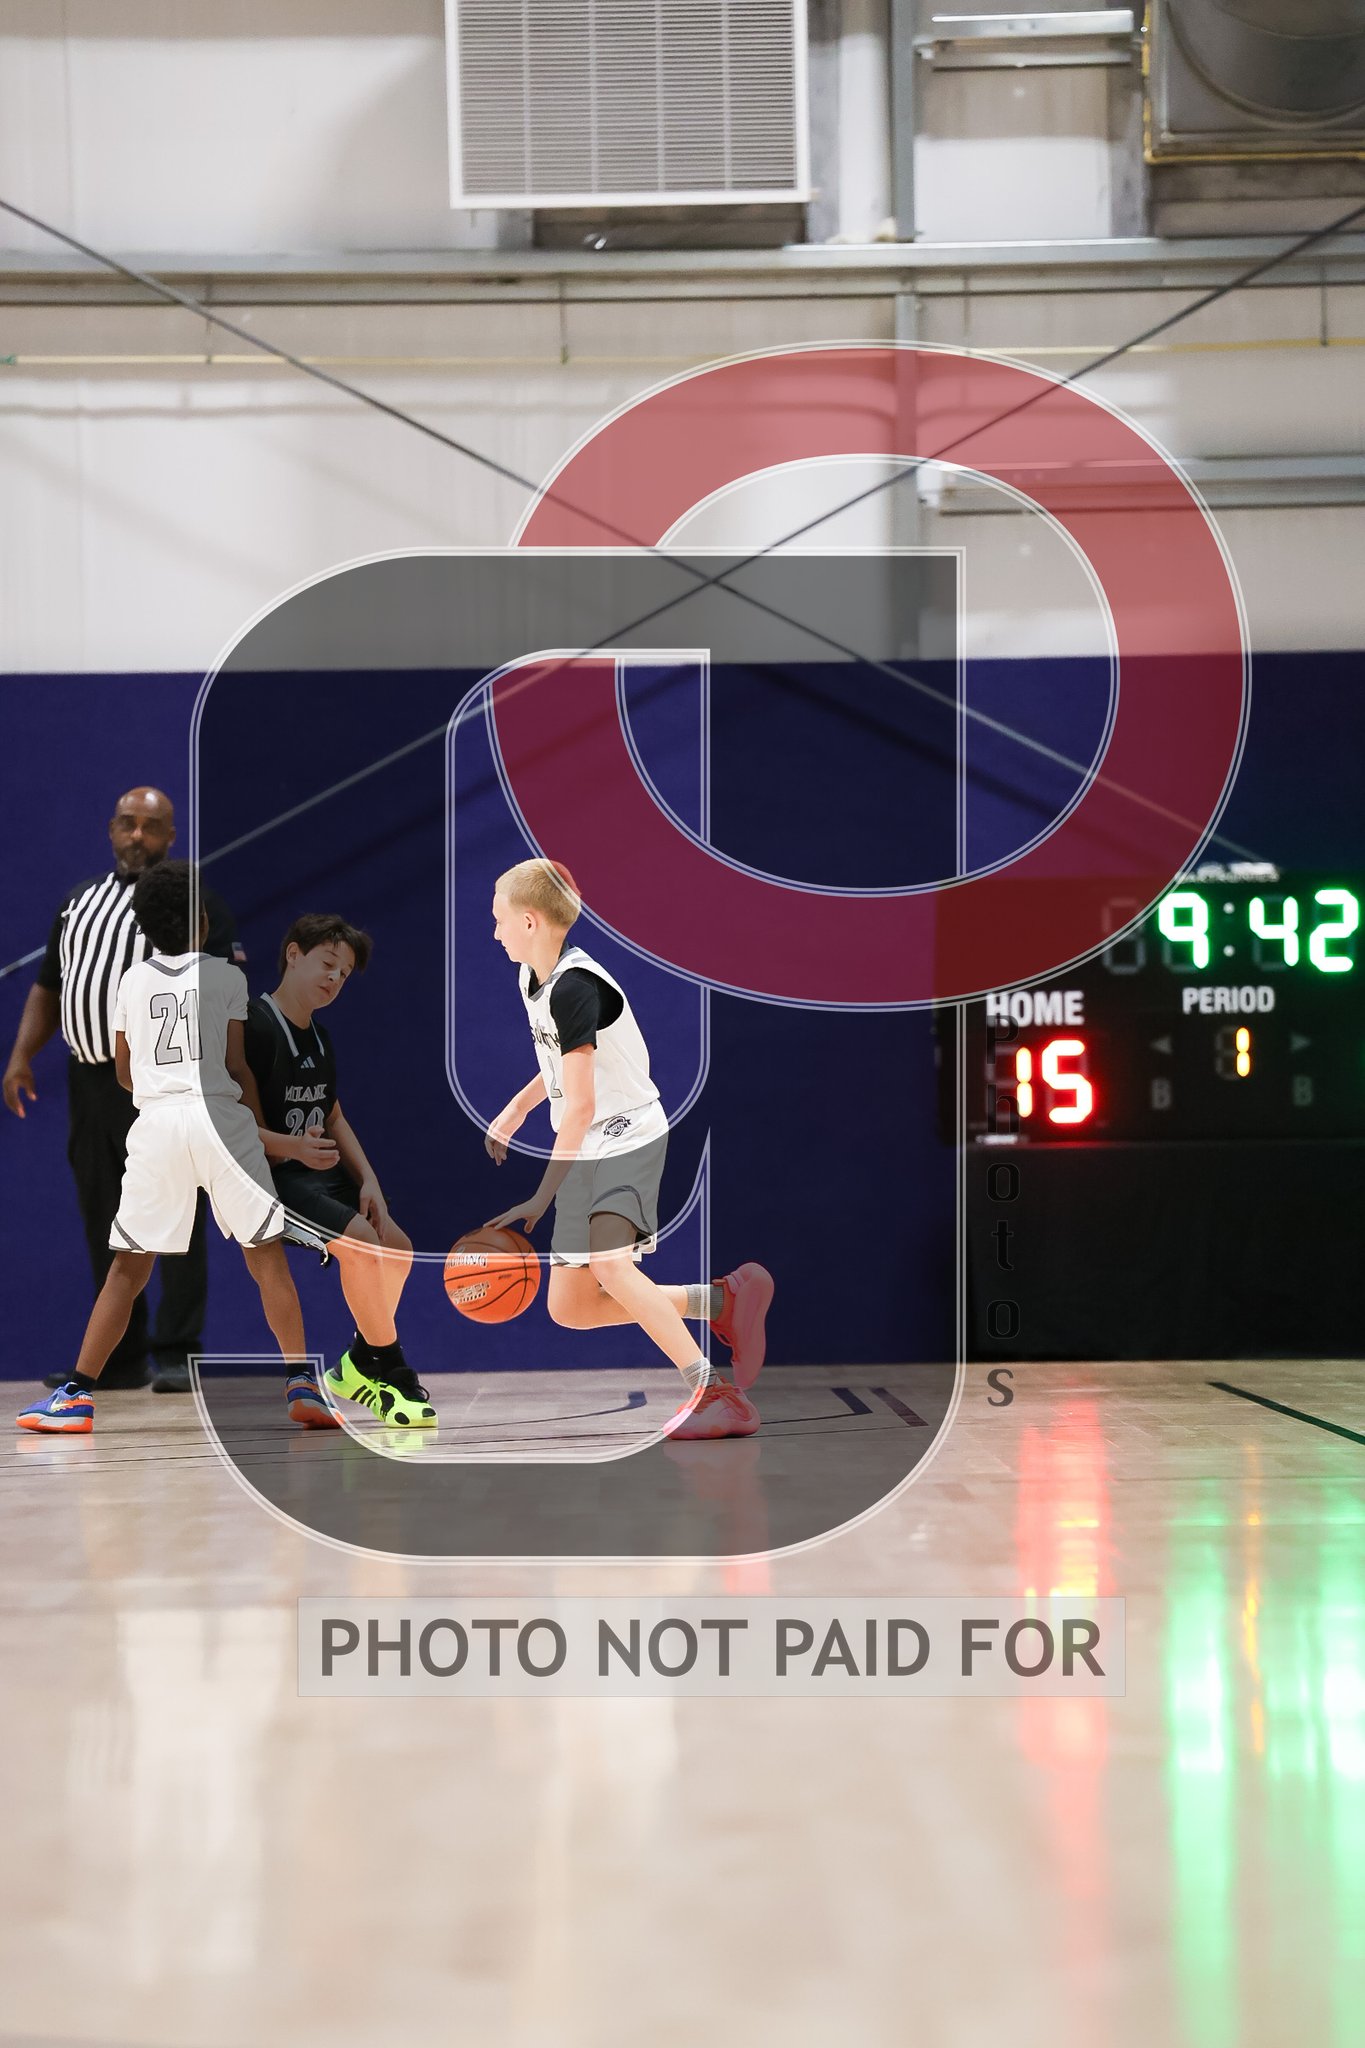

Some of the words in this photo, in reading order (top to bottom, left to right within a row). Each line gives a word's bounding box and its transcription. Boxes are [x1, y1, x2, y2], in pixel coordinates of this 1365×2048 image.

[1158, 889, 1359, 973] 9:42
[150, 989, 203, 1065] 21
[986, 990, 1085, 1027] HOME
[1182, 986, 1276, 1014] PERIOD
[1016, 1039, 1092, 1123] 15
[1236, 1027, 1250, 1077] 1
